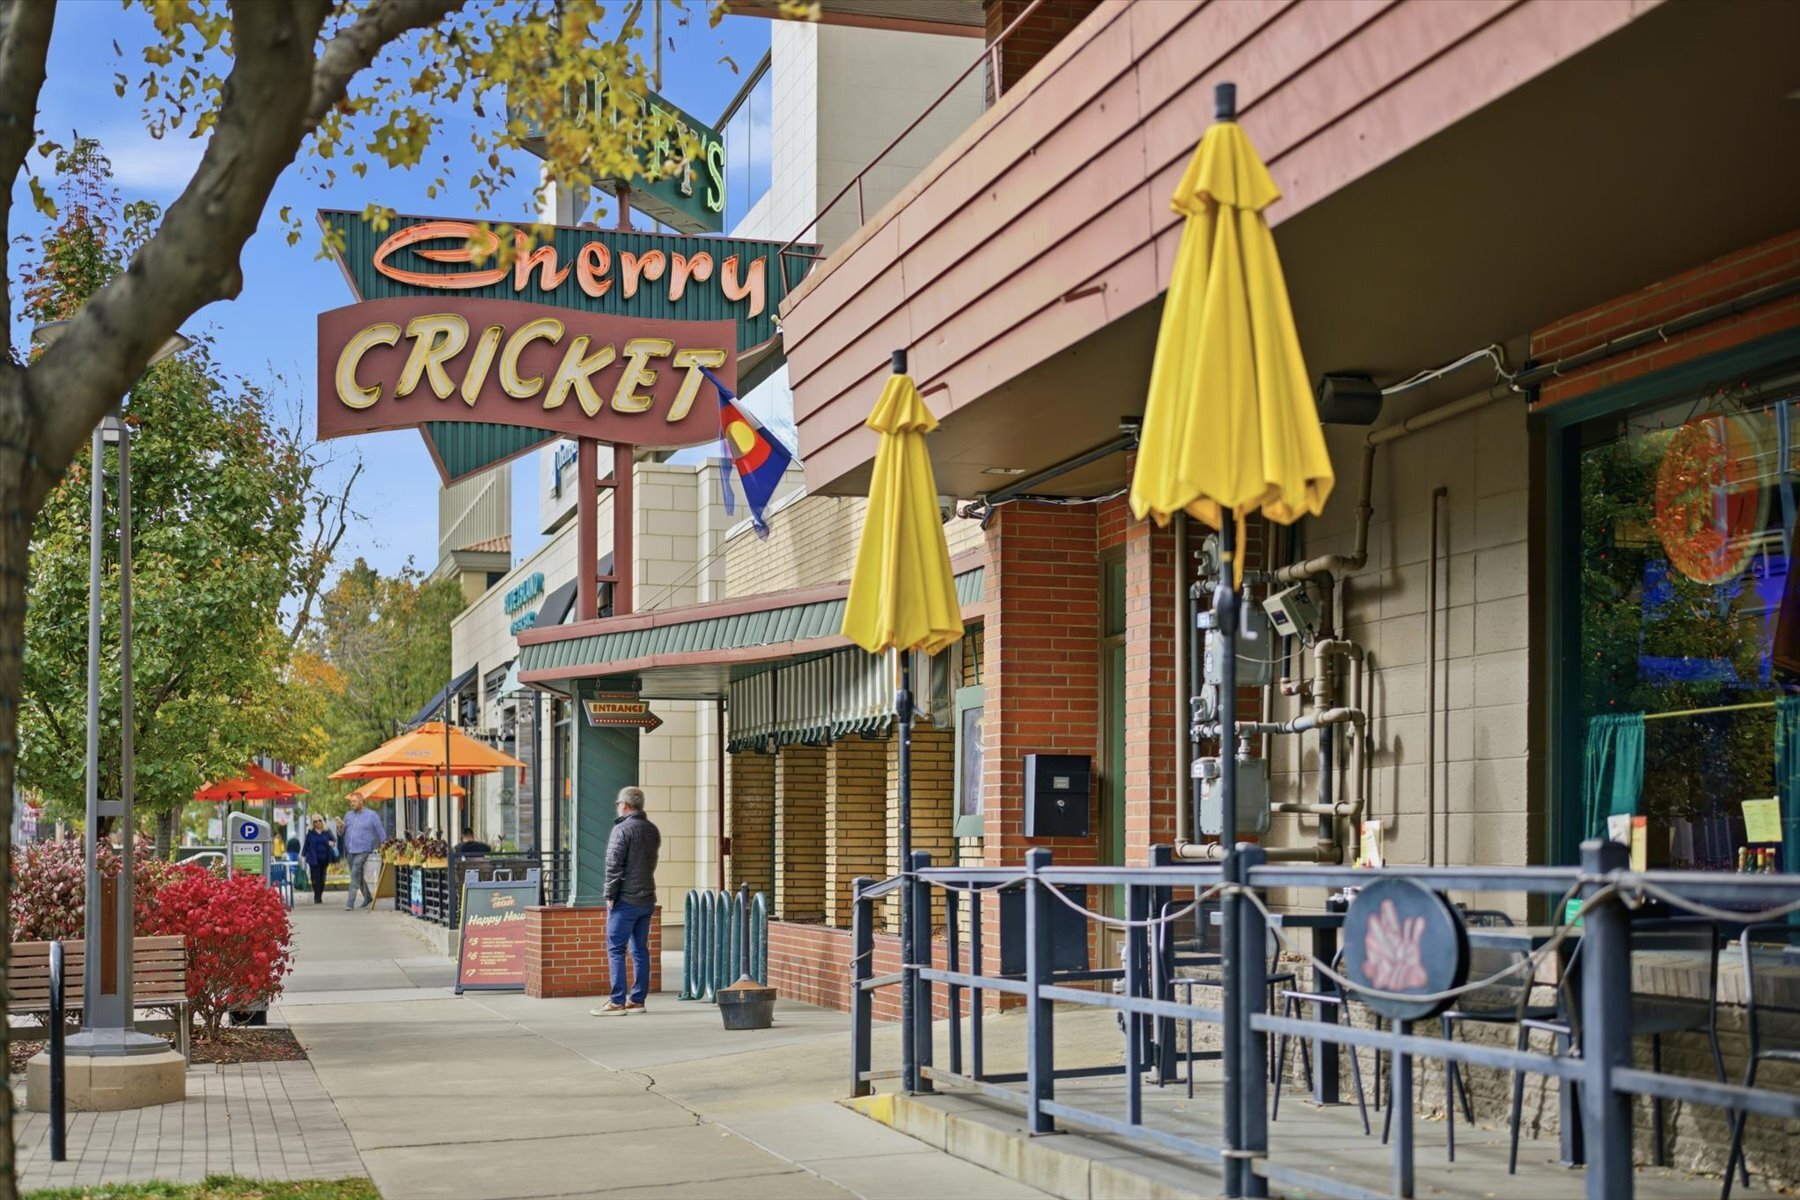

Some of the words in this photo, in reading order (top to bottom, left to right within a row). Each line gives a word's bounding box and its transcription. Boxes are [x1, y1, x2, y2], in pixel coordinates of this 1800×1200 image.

[373, 221, 767, 319] Cherry
[335, 313, 728, 422] CRICKET
[593, 704, 643, 713] ENTRANCE
[245, 825, 255, 837] P
[468, 914, 502, 926] Happy
